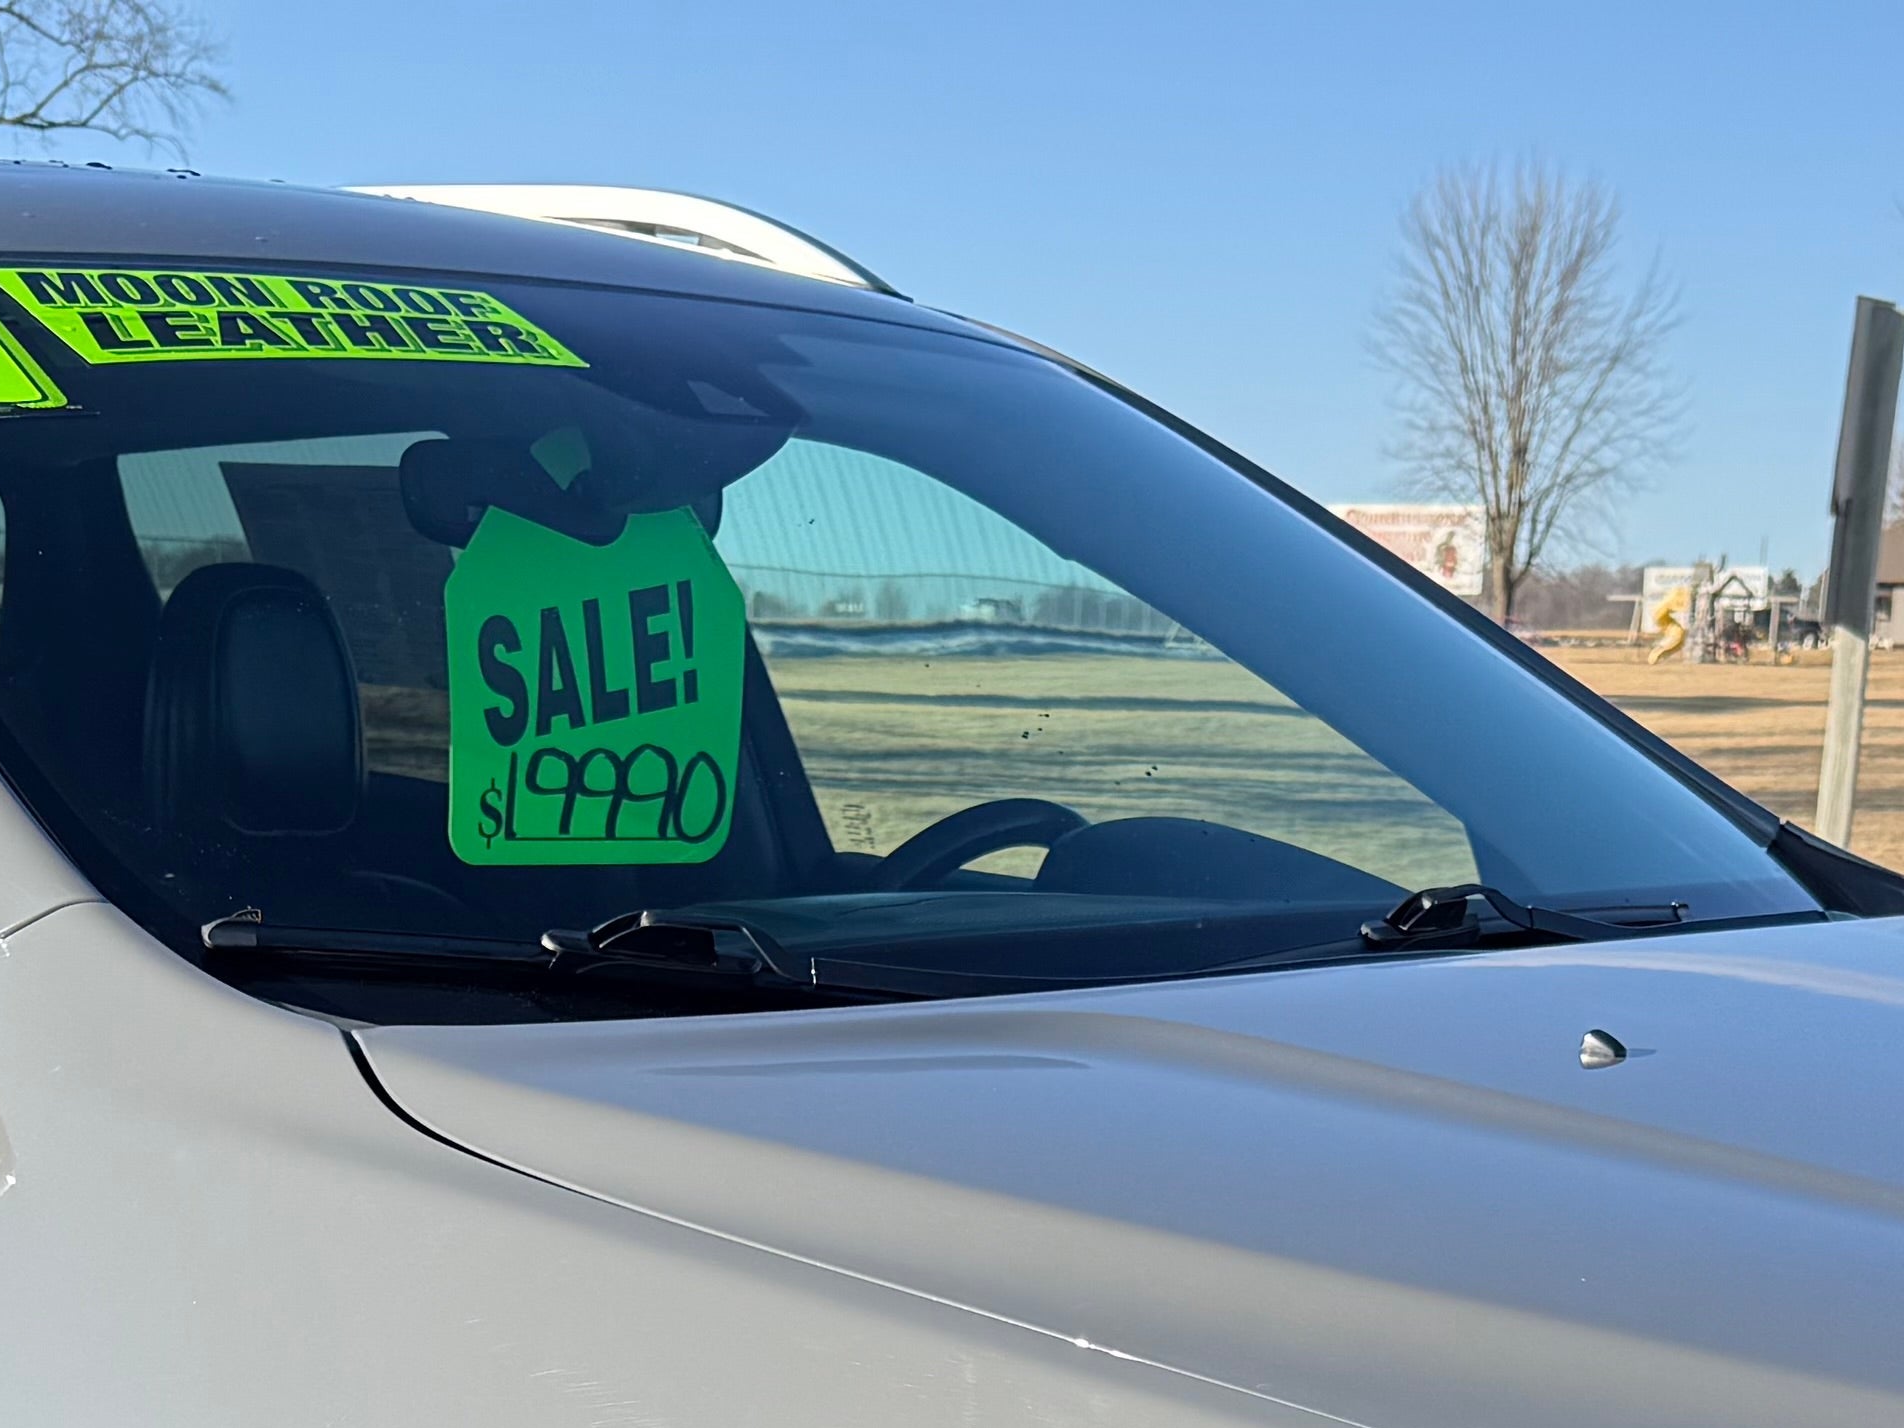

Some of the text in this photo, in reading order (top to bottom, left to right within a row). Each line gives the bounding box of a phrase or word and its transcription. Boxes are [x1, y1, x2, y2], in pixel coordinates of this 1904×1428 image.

[16, 271, 504, 319] MOON ROOF
[85, 309, 558, 357] LEATHER
[476, 579, 700, 748] SALE!
